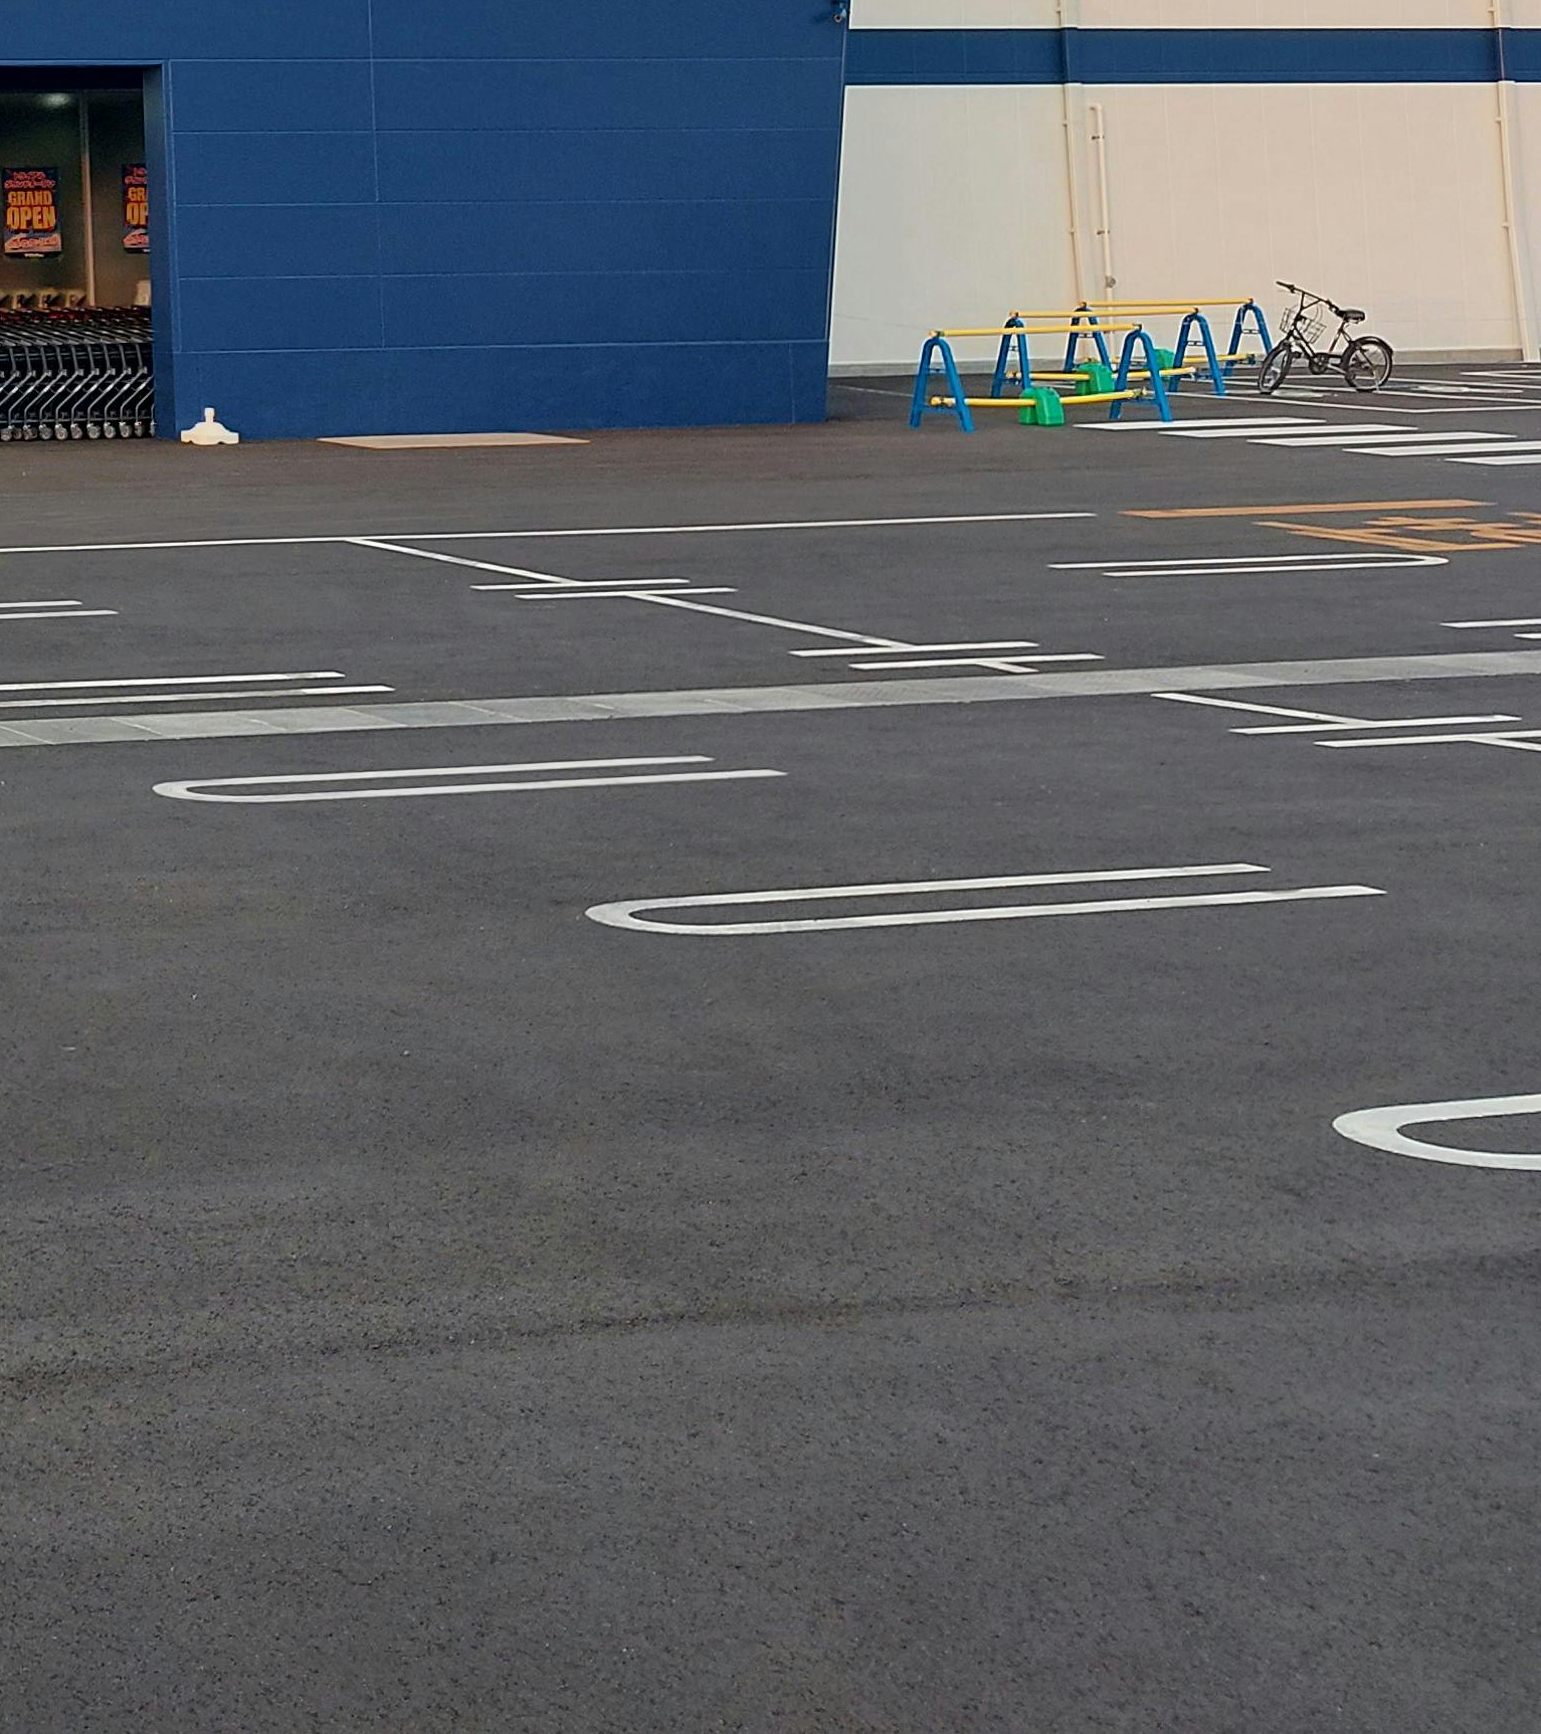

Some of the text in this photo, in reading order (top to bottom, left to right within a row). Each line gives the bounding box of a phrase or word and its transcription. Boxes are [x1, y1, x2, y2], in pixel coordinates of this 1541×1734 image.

[8, 191, 53, 206] GRAND
[6, 206, 56, 230] OPEN
[1251, 511, 1541, 552] 止ま
